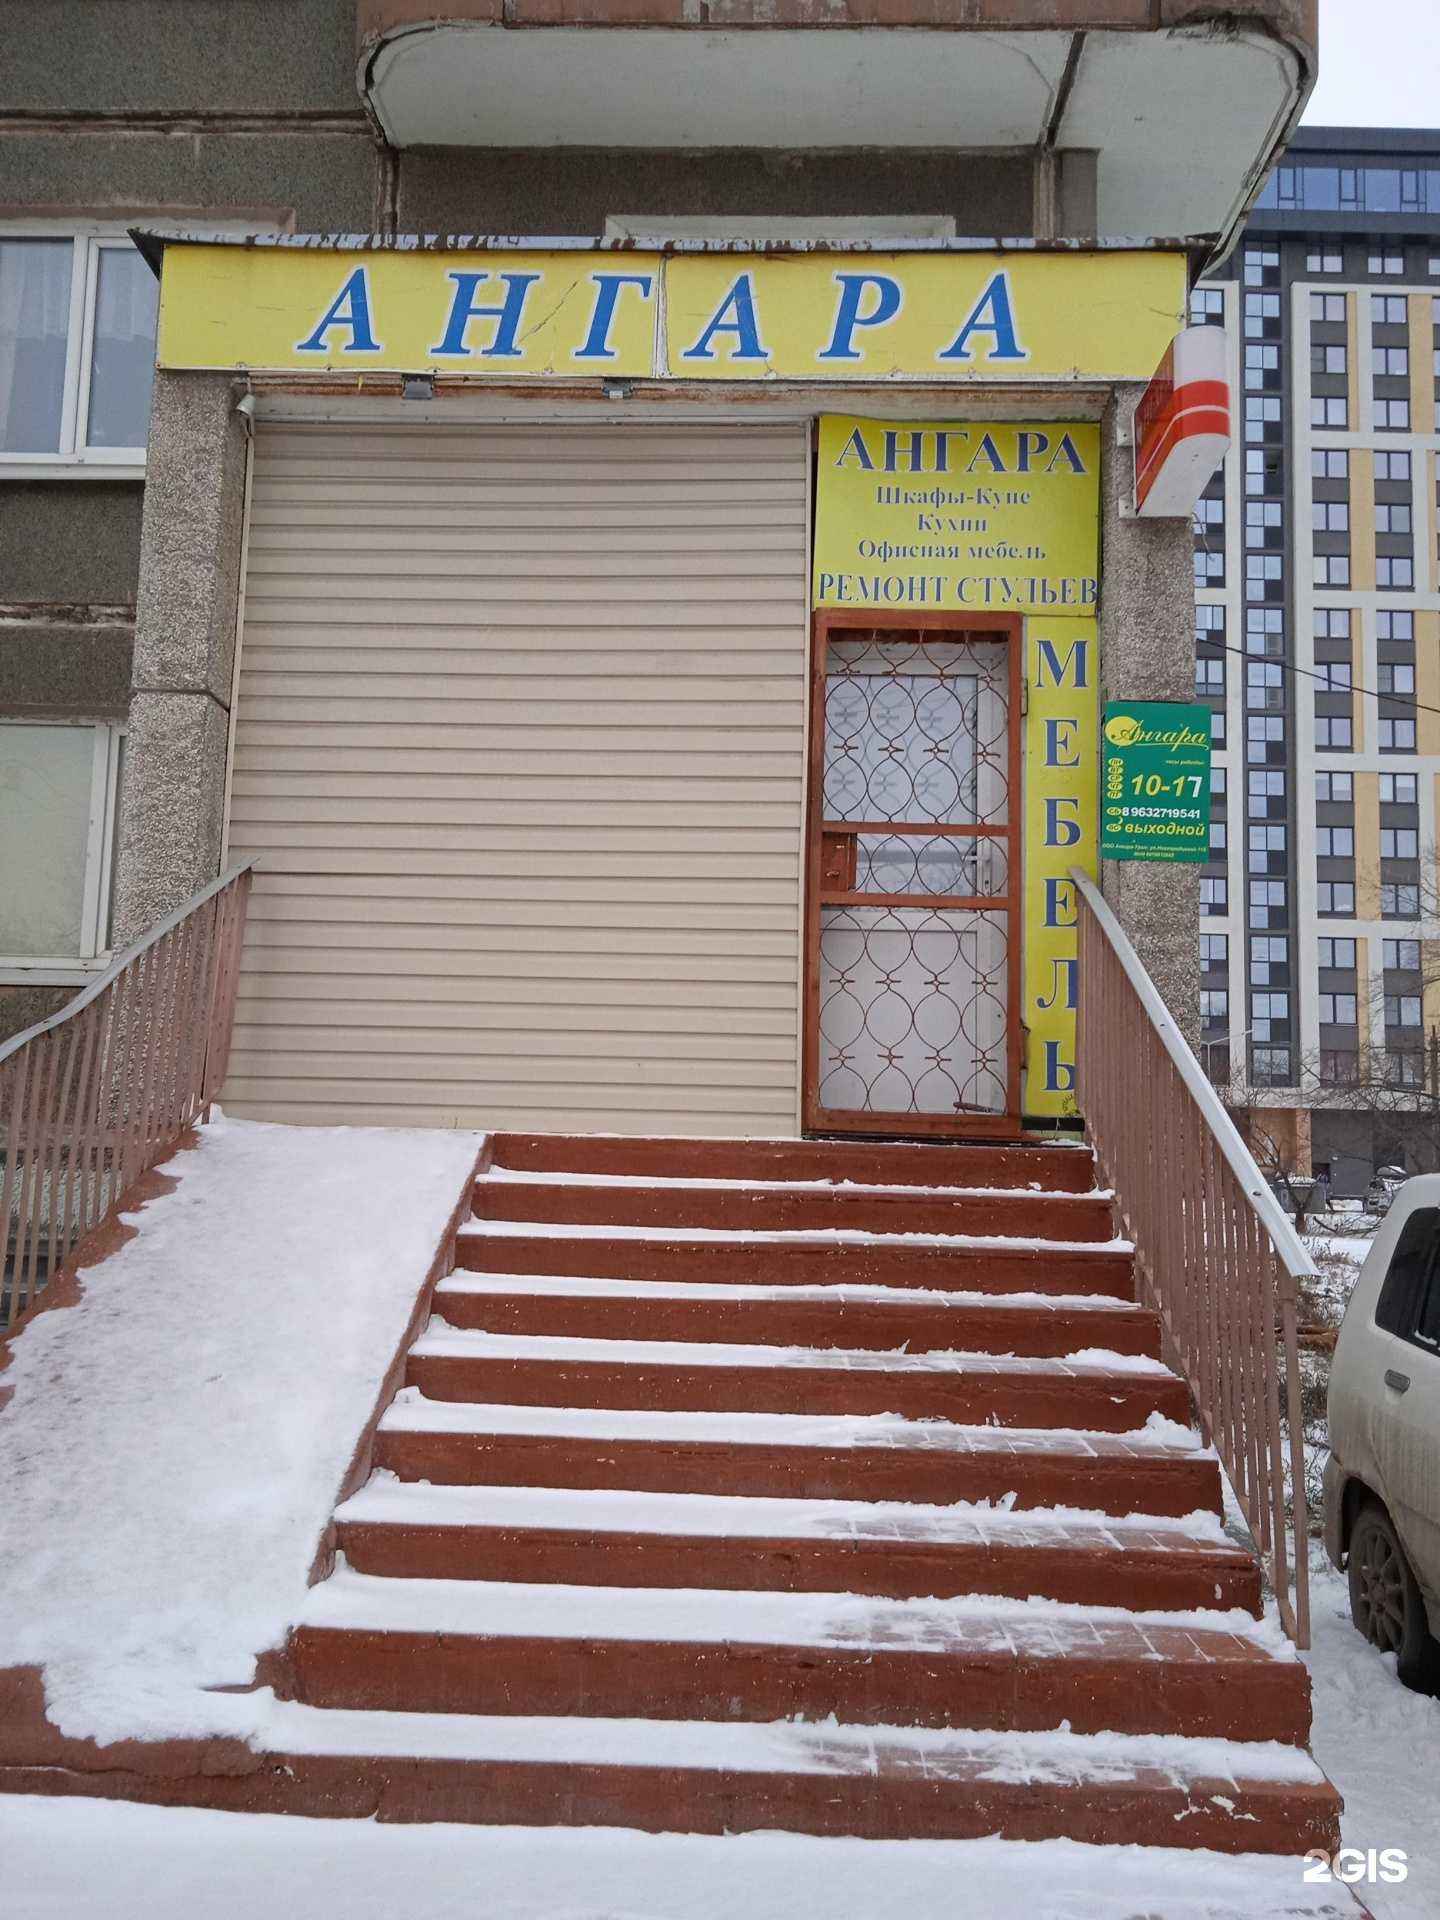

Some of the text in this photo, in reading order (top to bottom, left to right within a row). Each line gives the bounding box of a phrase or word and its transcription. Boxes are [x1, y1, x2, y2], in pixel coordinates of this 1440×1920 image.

[297, 268, 1027, 360] АНГАРА
[835, 425, 1087, 473] АНГАРА
[876, 486, 1031, 509] Шкафы-Купе
[917, 513, 987, 535] Кухни
[858, 539, 1046, 562] Офисная мебель
[819, 573, 1097, 604] РЕМОНТ СТУЛЬЕВ
[1112, 720, 1208, 752] Ангара
[1131, 774, 1203, 798] 10-17
[1125, 823, 1205, 836] выходной
[1035, 639, 1088, 1092] МЕБЕЛЬ
